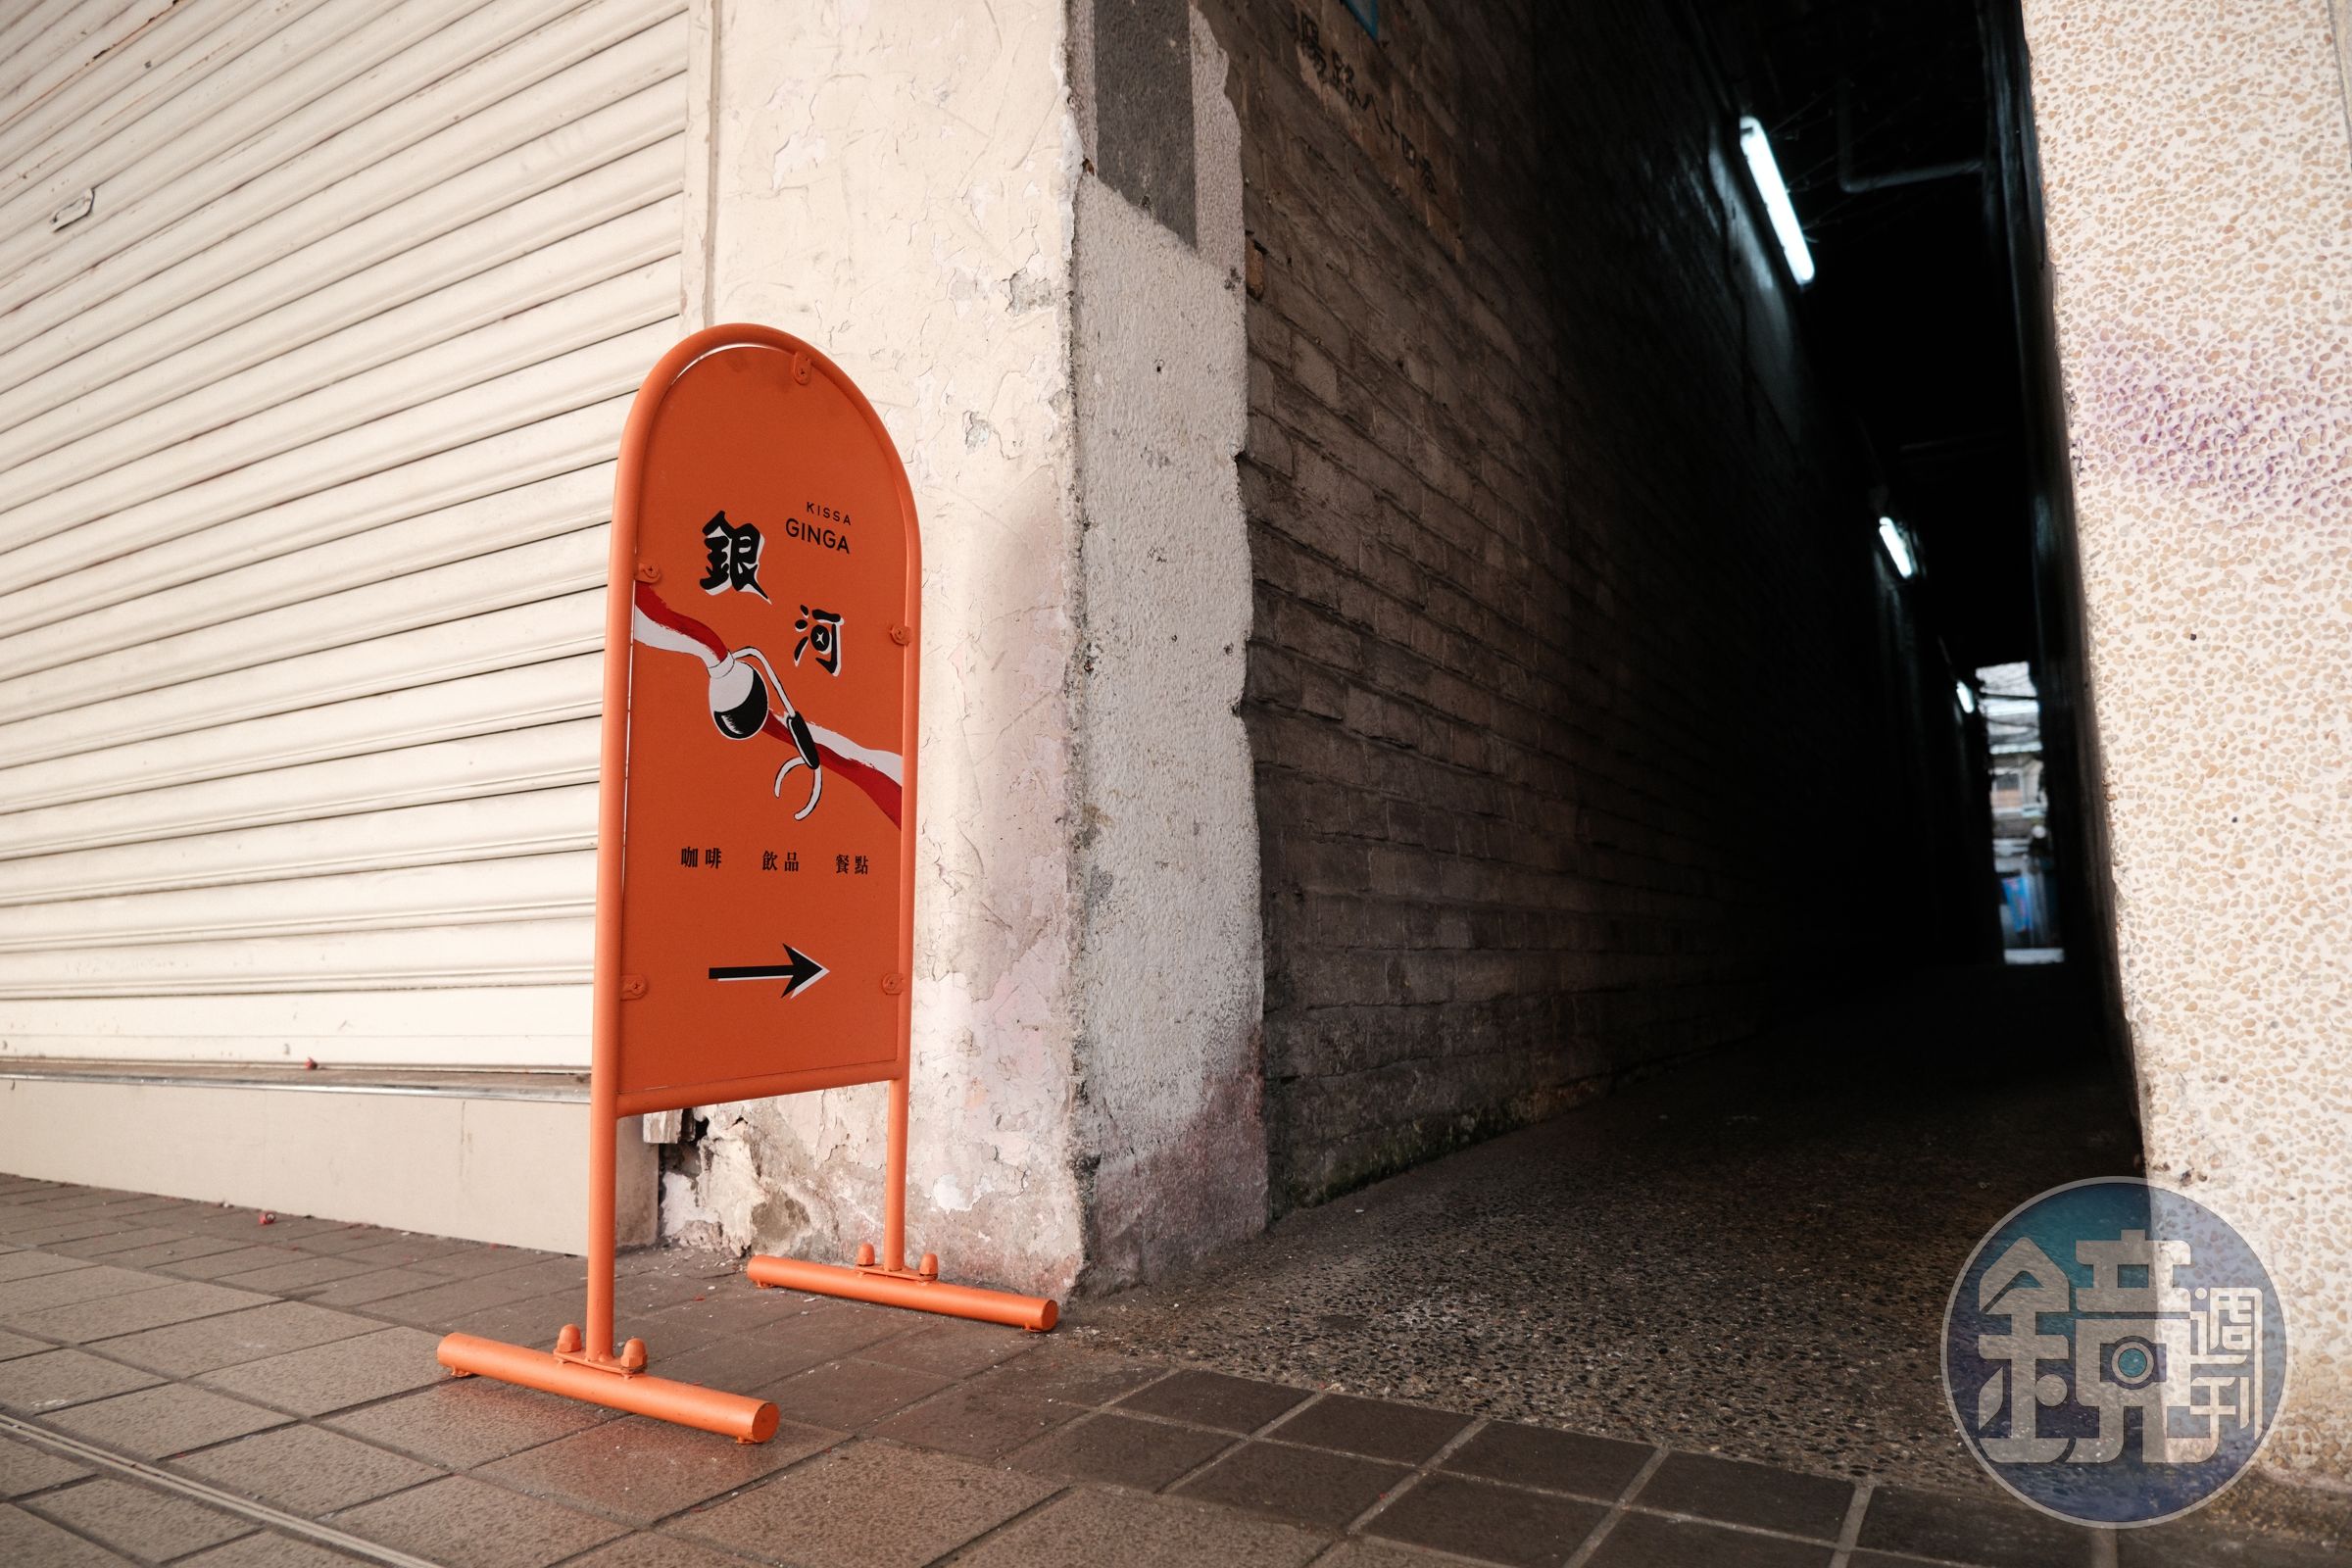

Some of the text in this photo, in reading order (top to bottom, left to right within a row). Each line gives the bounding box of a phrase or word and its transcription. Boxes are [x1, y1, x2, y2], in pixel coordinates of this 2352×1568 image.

[806, 501, 852, 526] KISSA
[785, 517, 851, 555] GINGA
[680, 846, 869, 875] 咖啡 飲品 餐點
